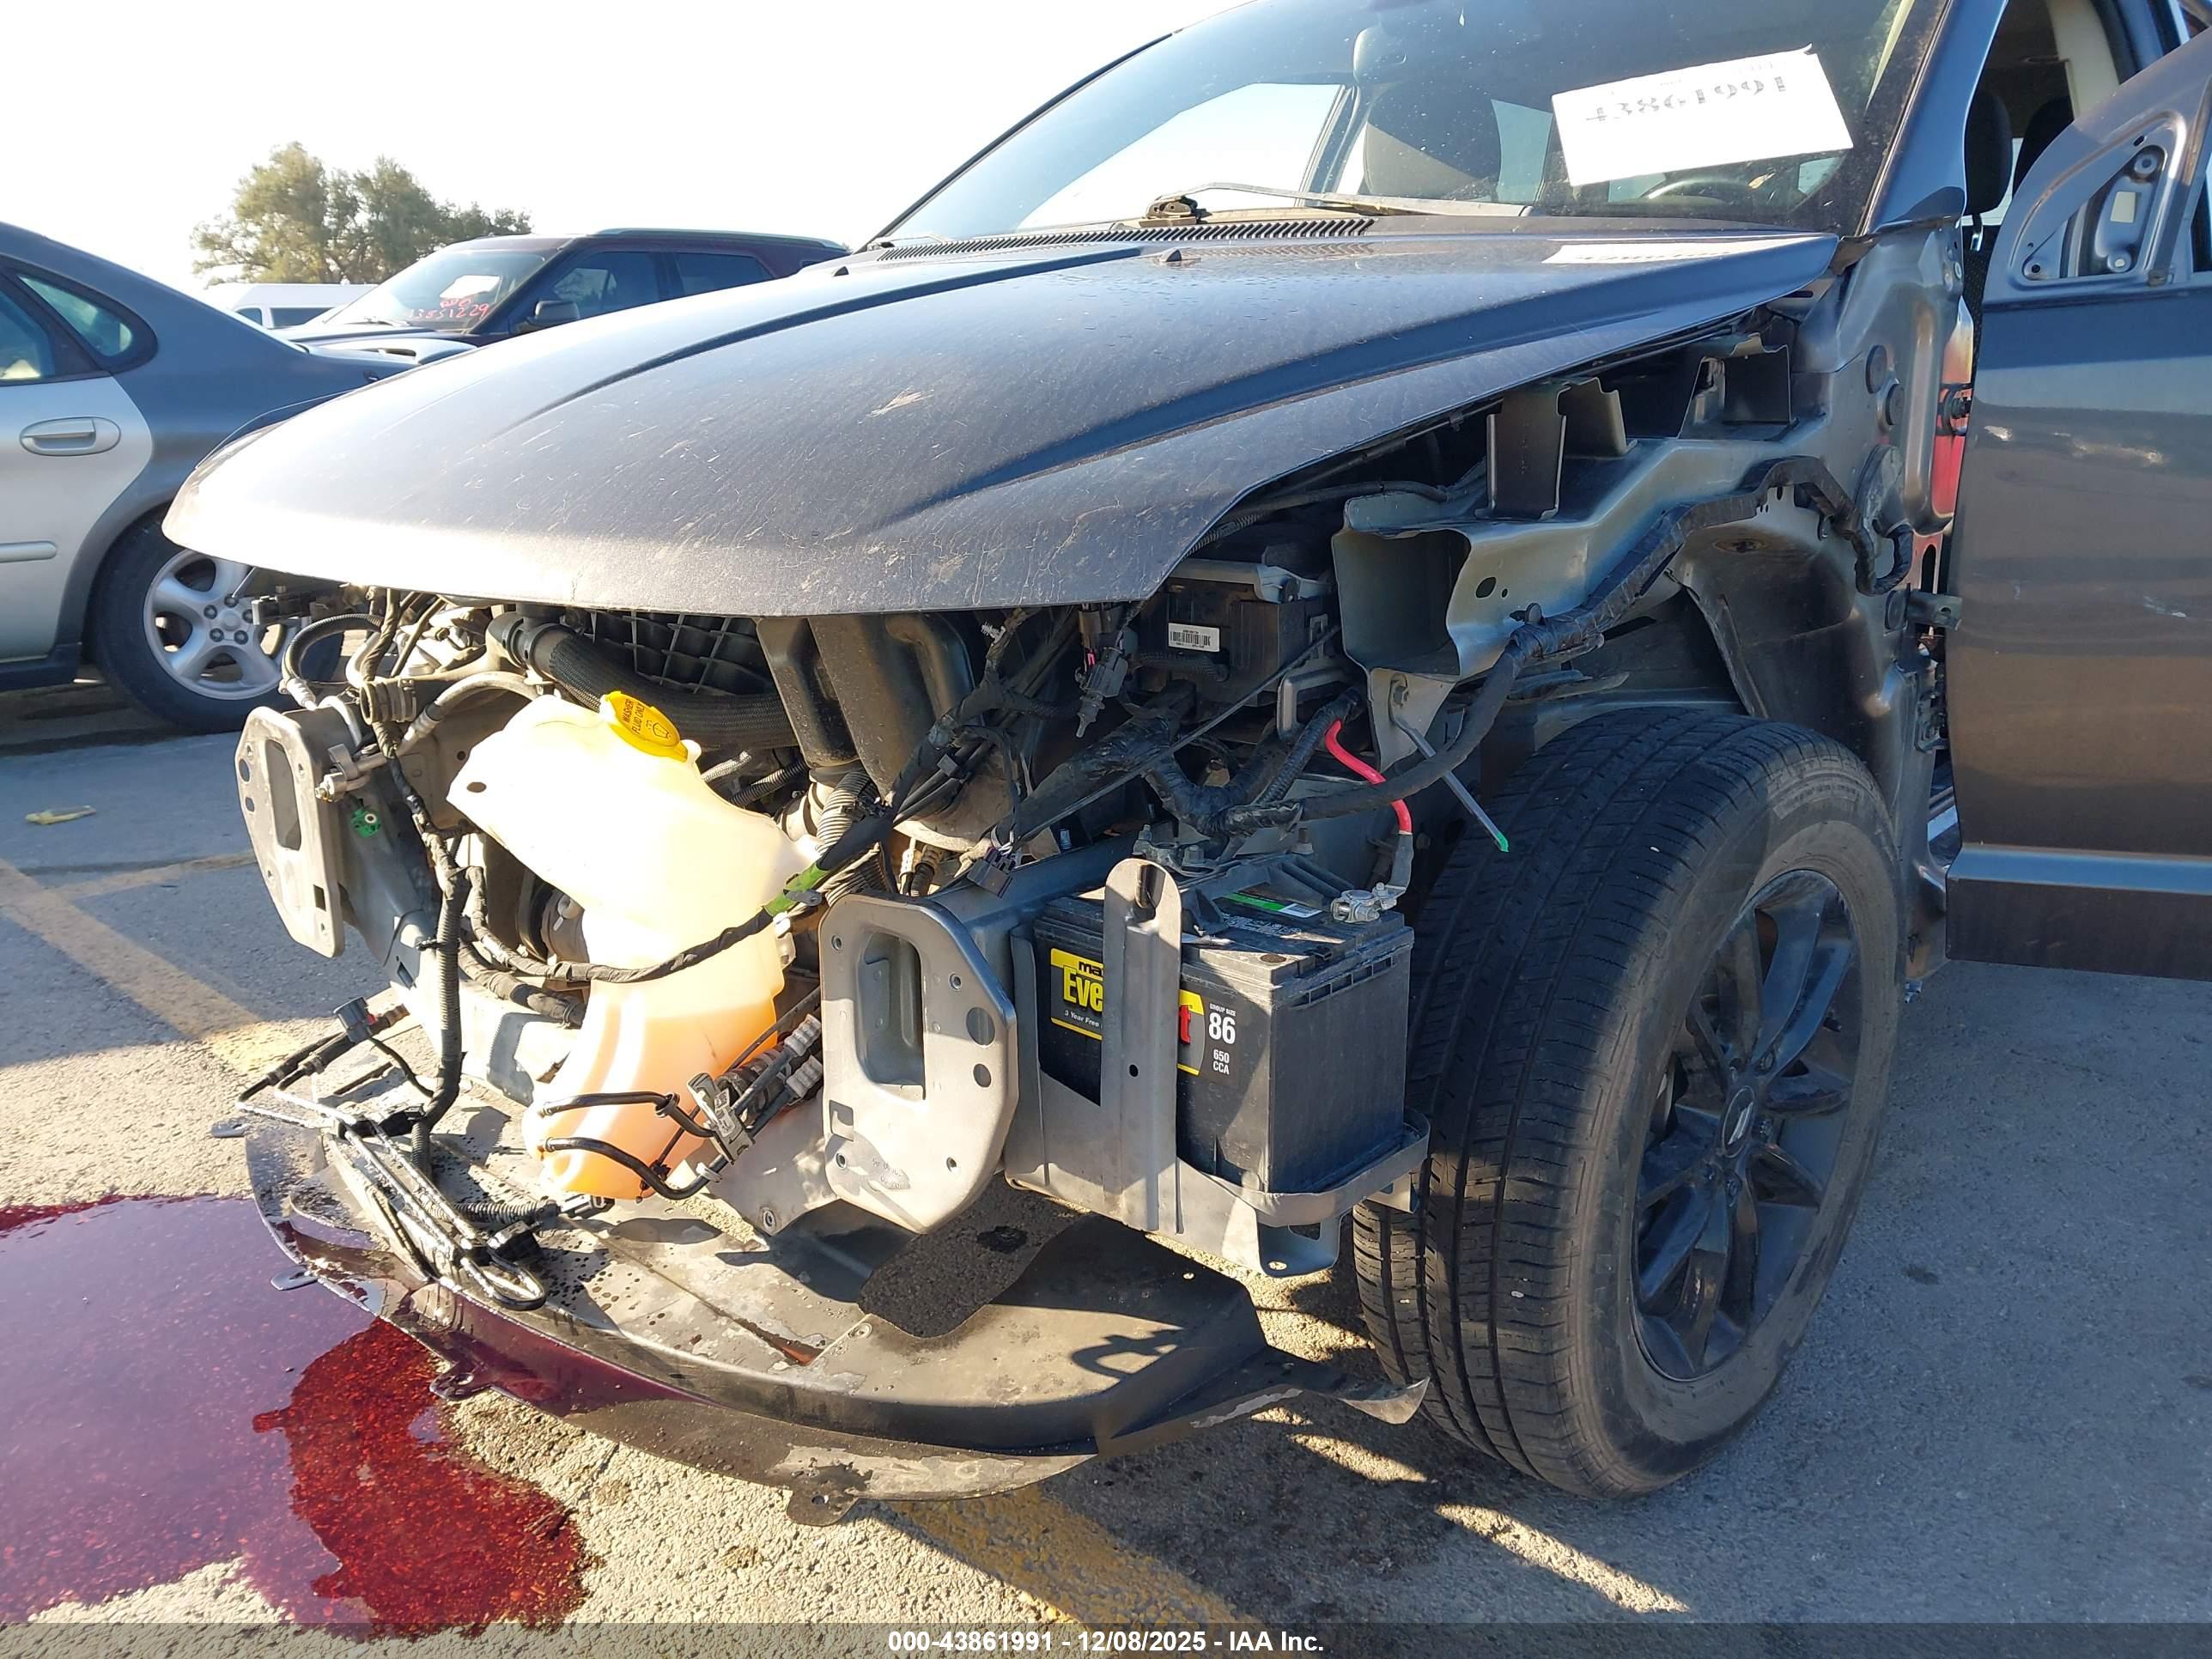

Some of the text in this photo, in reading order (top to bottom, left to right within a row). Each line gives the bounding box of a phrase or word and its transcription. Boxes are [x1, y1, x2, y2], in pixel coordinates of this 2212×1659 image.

[1585, 76, 1787, 122] 43861991
[622, 699, 634, 723] WASHER
[631, 716, 642, 735] FLUID
[1078, 961, 1103, 977] ma
[1063, 965, 1191, 1043] Eve t
[1209, 1003, 1237, 1017] GROUP SIZE
[1070, 1011, 1085, 1022] Year
[1085, 1017, 1100, 1028] Free
[1208, 1012, 1236, 1045] 86
[1212, 1048, 1231, 1065] 650
[1212, 1060, 1231, 1076] CCA
